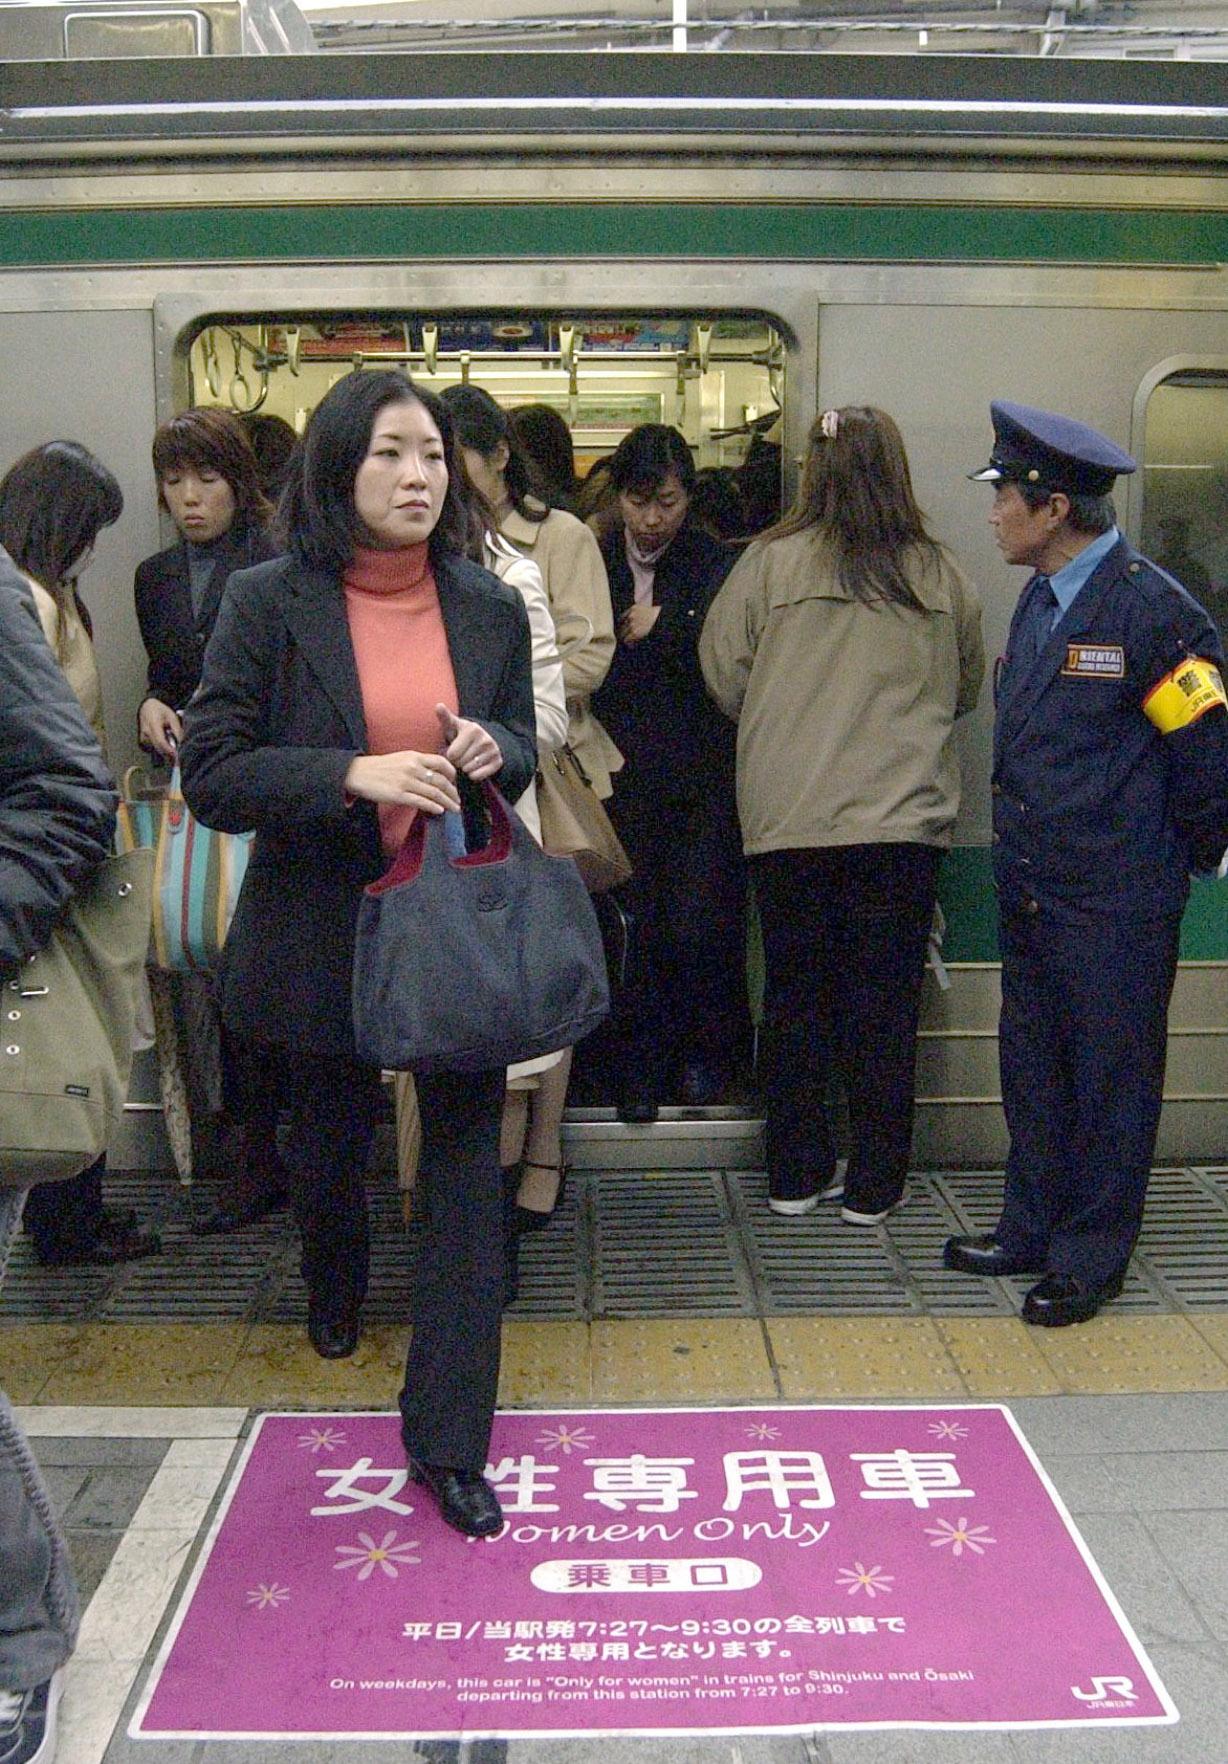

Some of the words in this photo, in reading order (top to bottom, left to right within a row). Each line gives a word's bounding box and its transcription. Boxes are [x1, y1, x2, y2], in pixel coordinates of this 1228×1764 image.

[310, 1449, 976, 1516] 女性専用車
[693, 1512, 831, 1547] Only
[568, 1563, 728, 1587] 乗車口
[503, 1638, 793, 1662] 女性専用となります。
[329, 1678, 355, 1689] On
[359, 1678, 452, 1691] weekdays,
[456, 1677, 489, 1688] this
[492, 1678, 523, 1688] car
[526, 1676, 541, 1687] is
[546, 1675, 594, 1688] "Only
[598, 1675, 624, 1687] for
[627, 1674, 699, 1687] women"
[703, 1674, 720, 1685] in
[723, 1673, 775, 1685] trains
[778, 1672, 804, 1683] for
[807, 1669, 884, 1684] Shinjuku
[888, 1670, 921, 1681] and
[1070, 1675, 1140, 1701] JR
[456, 1690, 543, 1703] departing
[547, 1689, 589, 1700] from
[593, 1688, 626, 1700] this
[629, 1687, 690, 1699] station
[694, 1687, 736, 1698] from
[740, 1686, 778, 1697] 7:27
[783, 1685, 801, 1696] to
[804, 1683, 849, 1695] 9:30.
